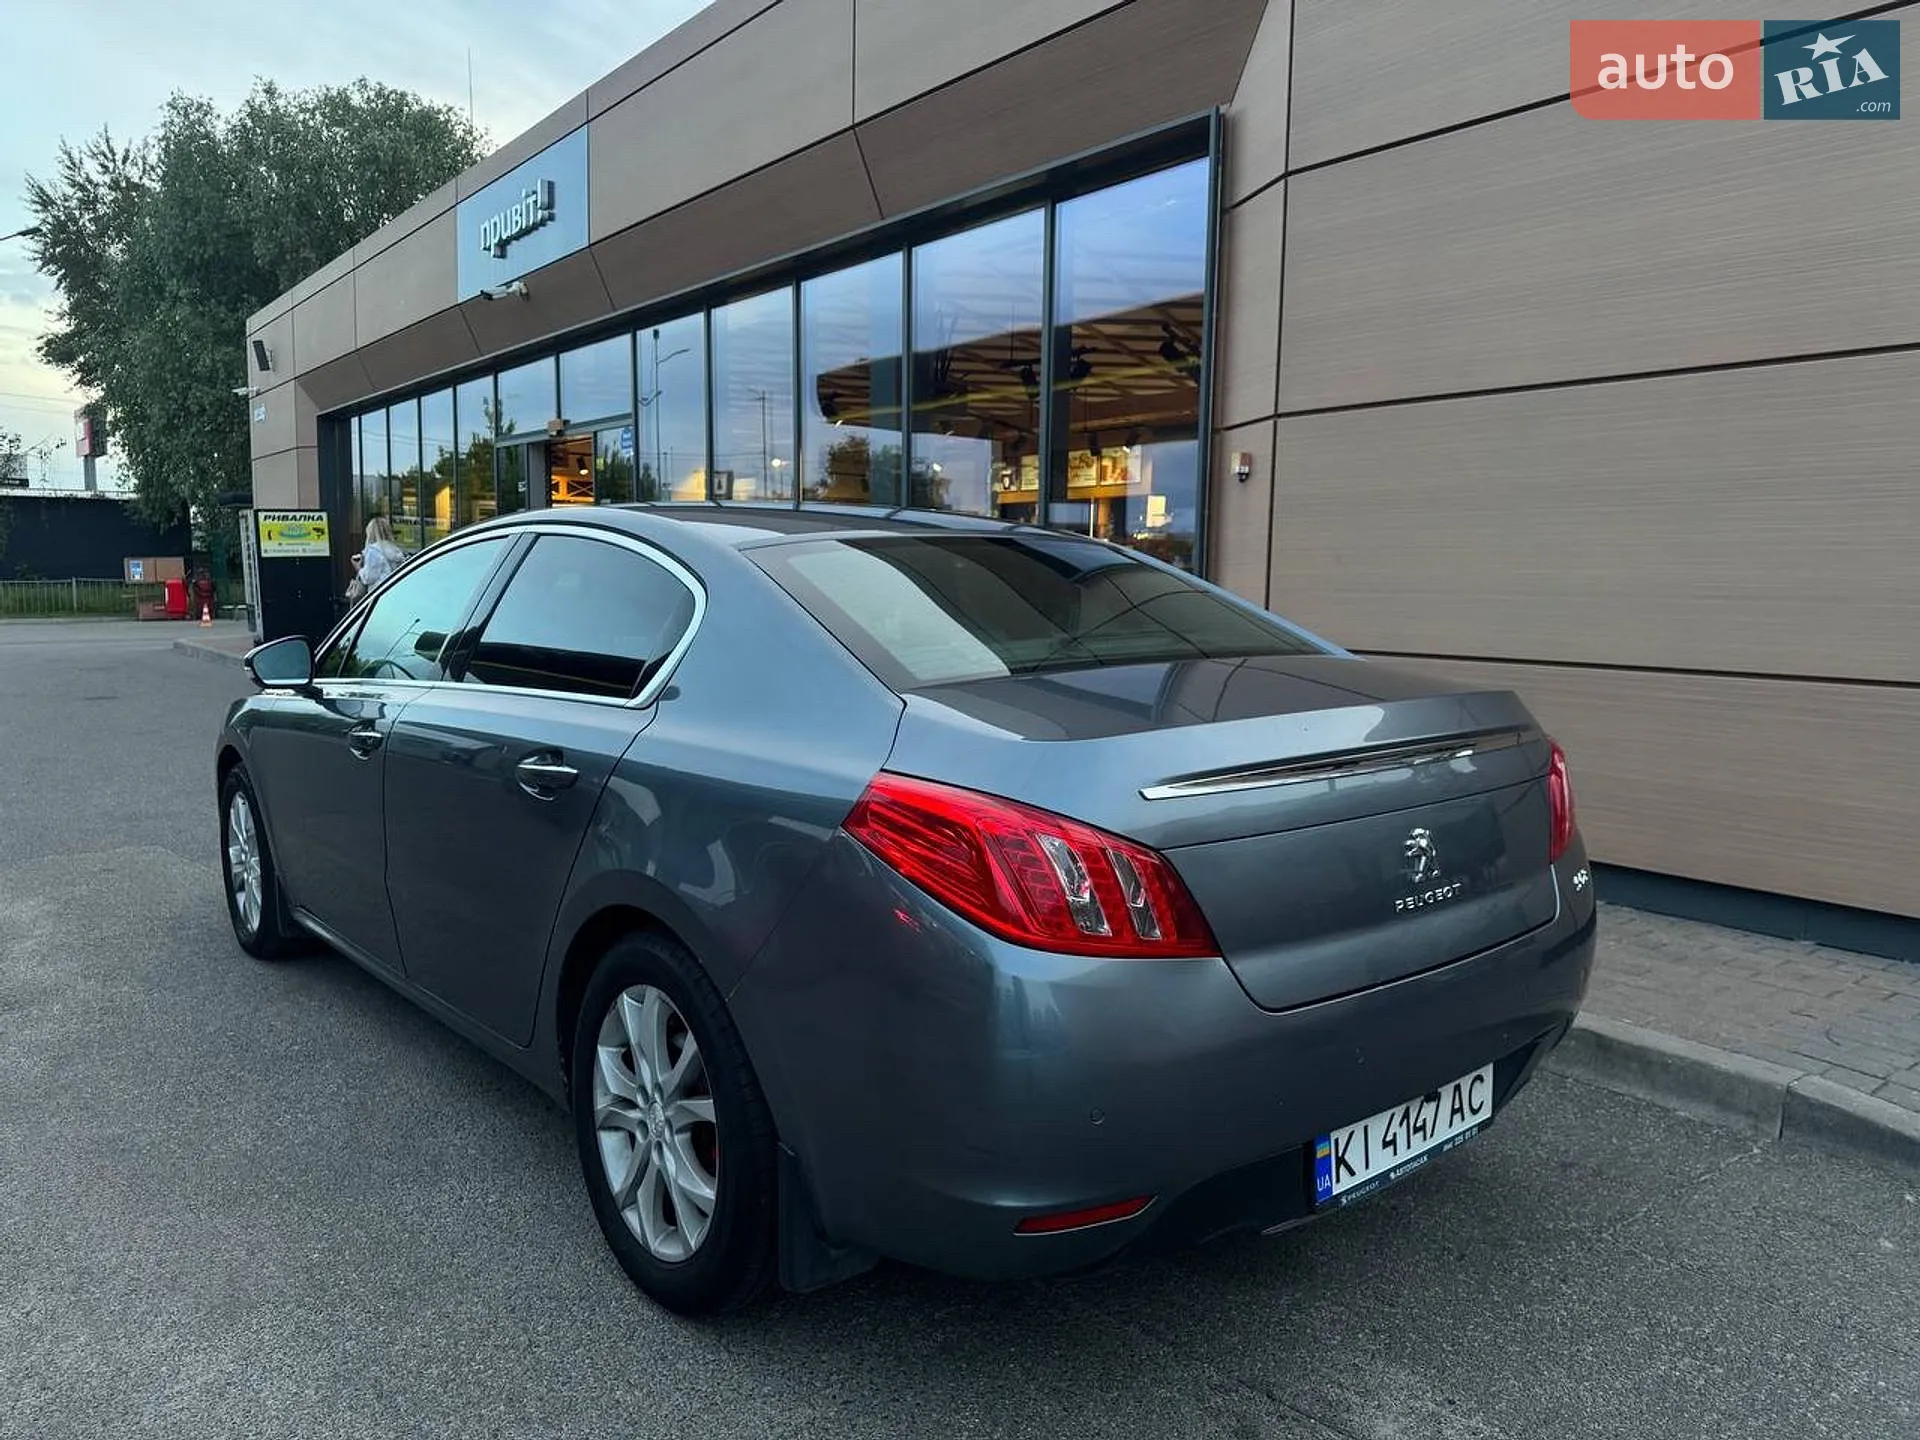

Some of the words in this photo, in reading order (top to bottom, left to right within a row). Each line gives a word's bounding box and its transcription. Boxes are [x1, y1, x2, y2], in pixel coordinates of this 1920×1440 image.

[1395, 883, 1462, 912] PEUGEOT
[1333, 1124, 1370, 1184] KI
[1382, 1091, 1441, 1157] 4147
[1449, 1073, 1485, 1129] AC
[1316, 1175, 1332, 1192] UA
